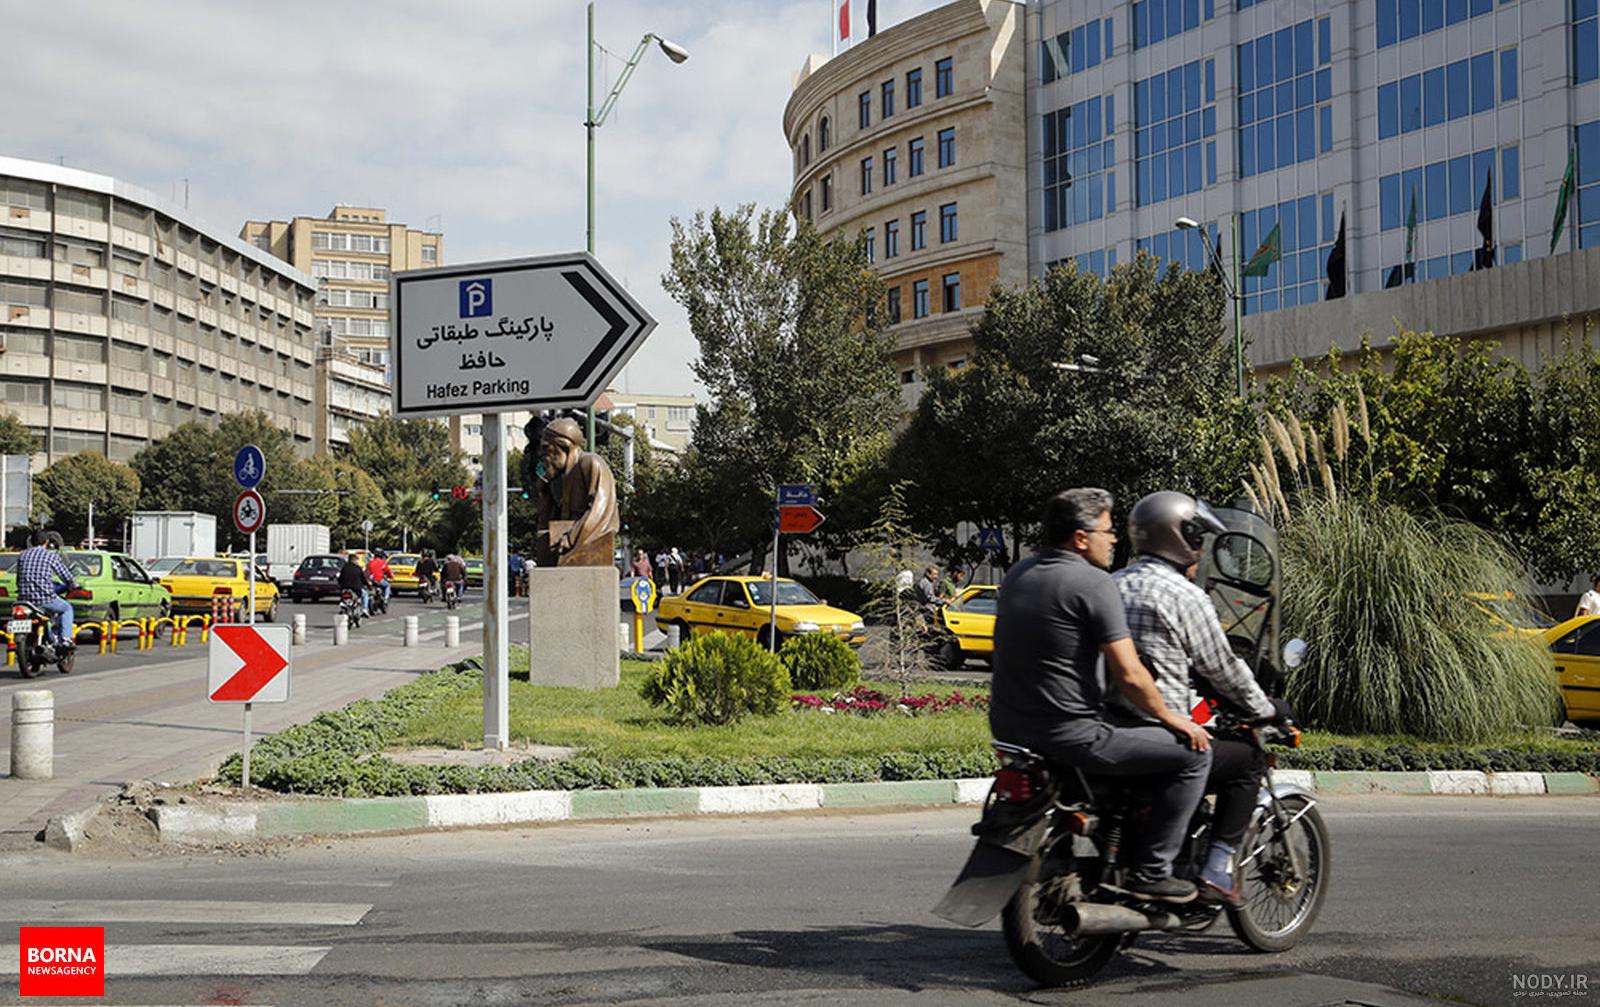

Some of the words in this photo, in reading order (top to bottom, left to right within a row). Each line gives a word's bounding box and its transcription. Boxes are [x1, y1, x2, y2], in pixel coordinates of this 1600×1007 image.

[416, 323, 478, 350] طبقاتی
[484, 315, 555, 342] پارکینگ
[458, 351, 506, 371] حافظ
[426, 382, 468, 399] Hafez
[472, 377, 530, 397] Parking
